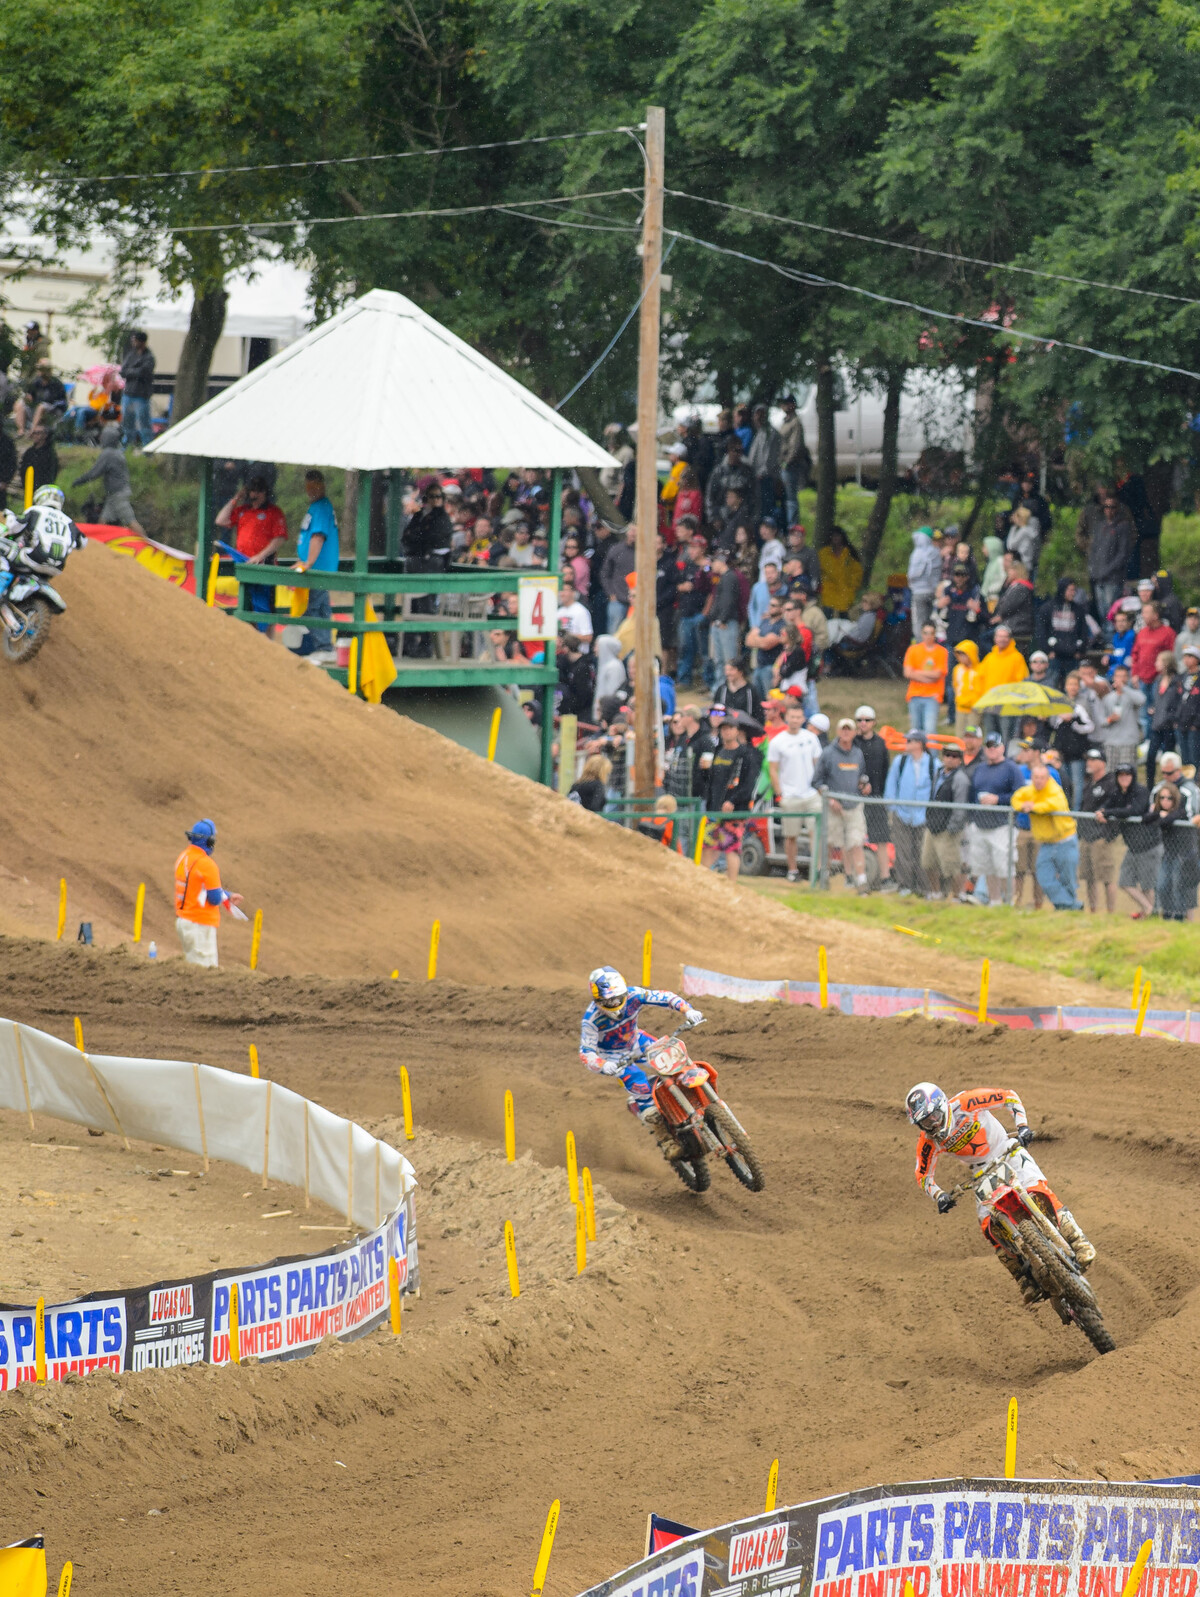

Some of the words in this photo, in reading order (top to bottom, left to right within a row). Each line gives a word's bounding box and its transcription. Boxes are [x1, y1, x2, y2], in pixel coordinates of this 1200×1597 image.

[45, 517, 67, 537] 317
[531, 591, 544, 634] 4
[152, 1289, 178, 1321] LUCAS
[179, 1286, 192, 1315] OIL
[287, 1260, 348, 1315] PARTS
[213, 1322, 282, 1363] UNIMITED
[731, 1531, 768, 1576] LUCAS
[767, 1525, 787, 1566] OIL
[816, 1504, 934, 1581] PARTS
[943, 1501, 1075, 1560] PARTS
